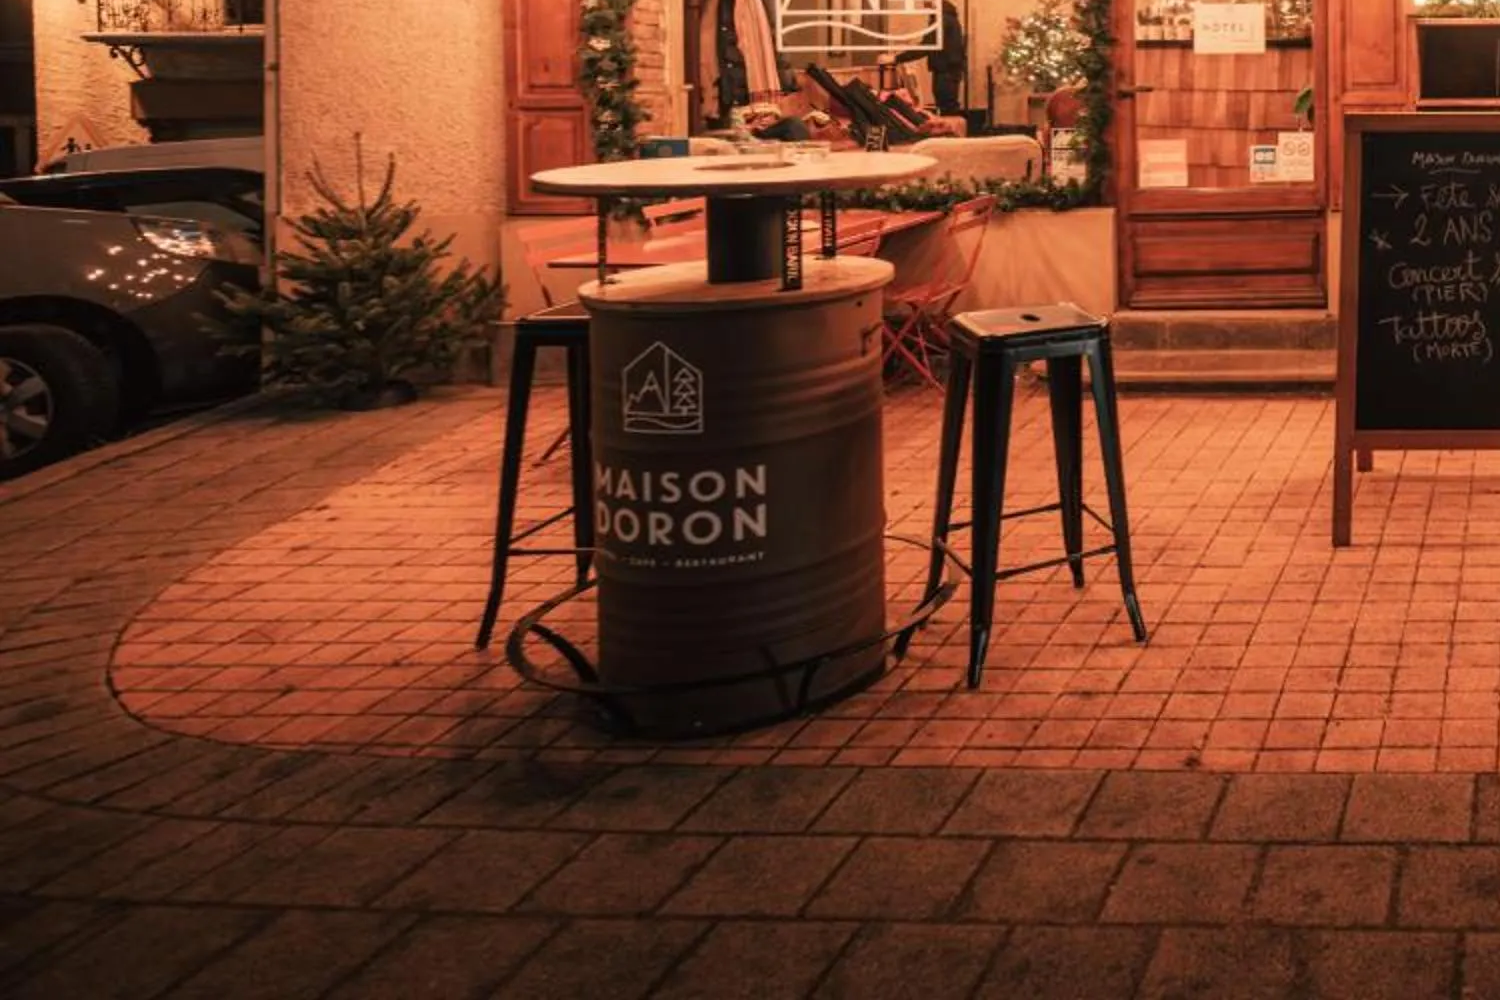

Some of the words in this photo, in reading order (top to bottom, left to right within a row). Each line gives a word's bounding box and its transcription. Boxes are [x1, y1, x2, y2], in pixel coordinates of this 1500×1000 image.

[1410, 213, 1432, 247] 2
[1443, 210, 1493, 246] ANS
[596, 462, 767, 503] MAISON
[596, 502, 767, 546] DORON
